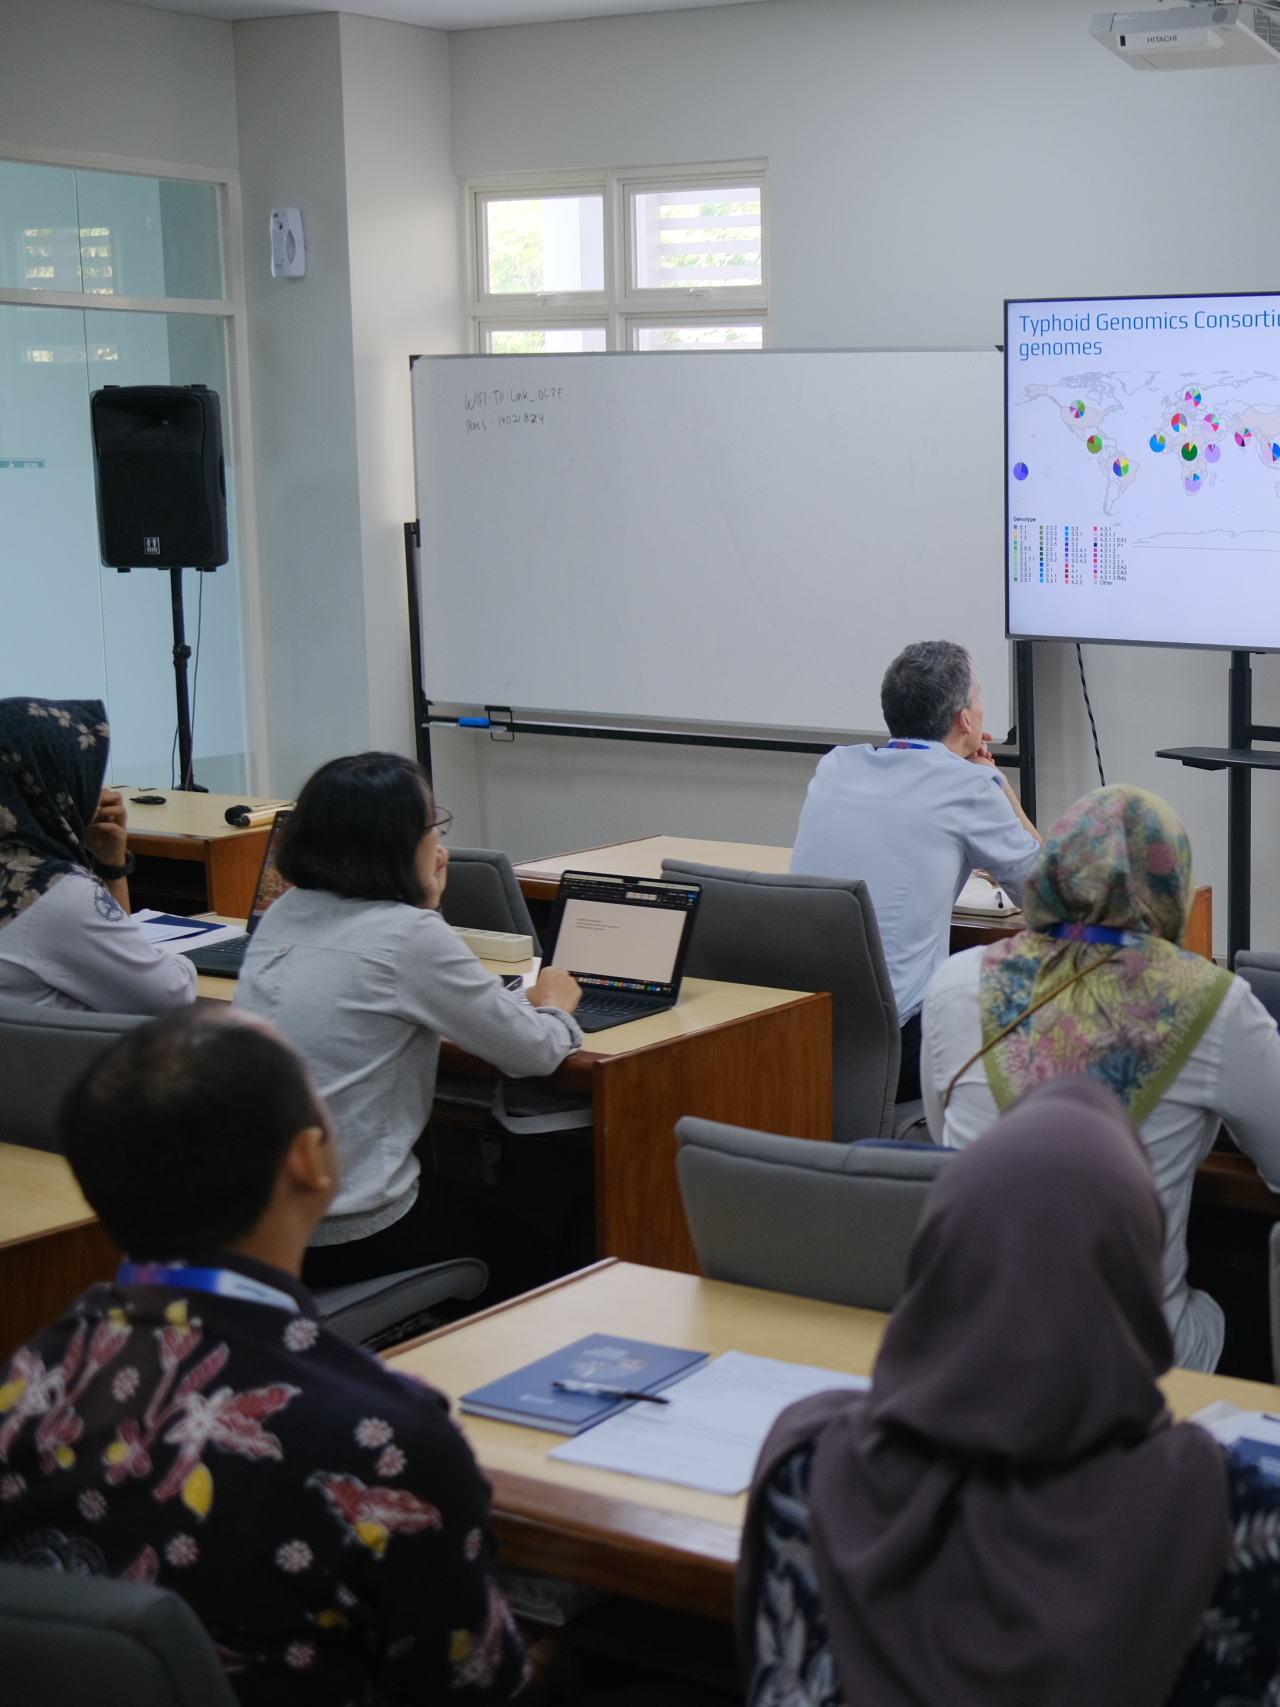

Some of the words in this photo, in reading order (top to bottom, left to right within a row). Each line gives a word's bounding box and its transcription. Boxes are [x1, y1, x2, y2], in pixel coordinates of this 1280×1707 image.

[1147, 35, 1177, 43] HITACHI
[1018, 313, 1090, 337] Typhoid
[1096, 312, 1188, 330] Genomics
[1018, 340, 1102, 361] genomes
